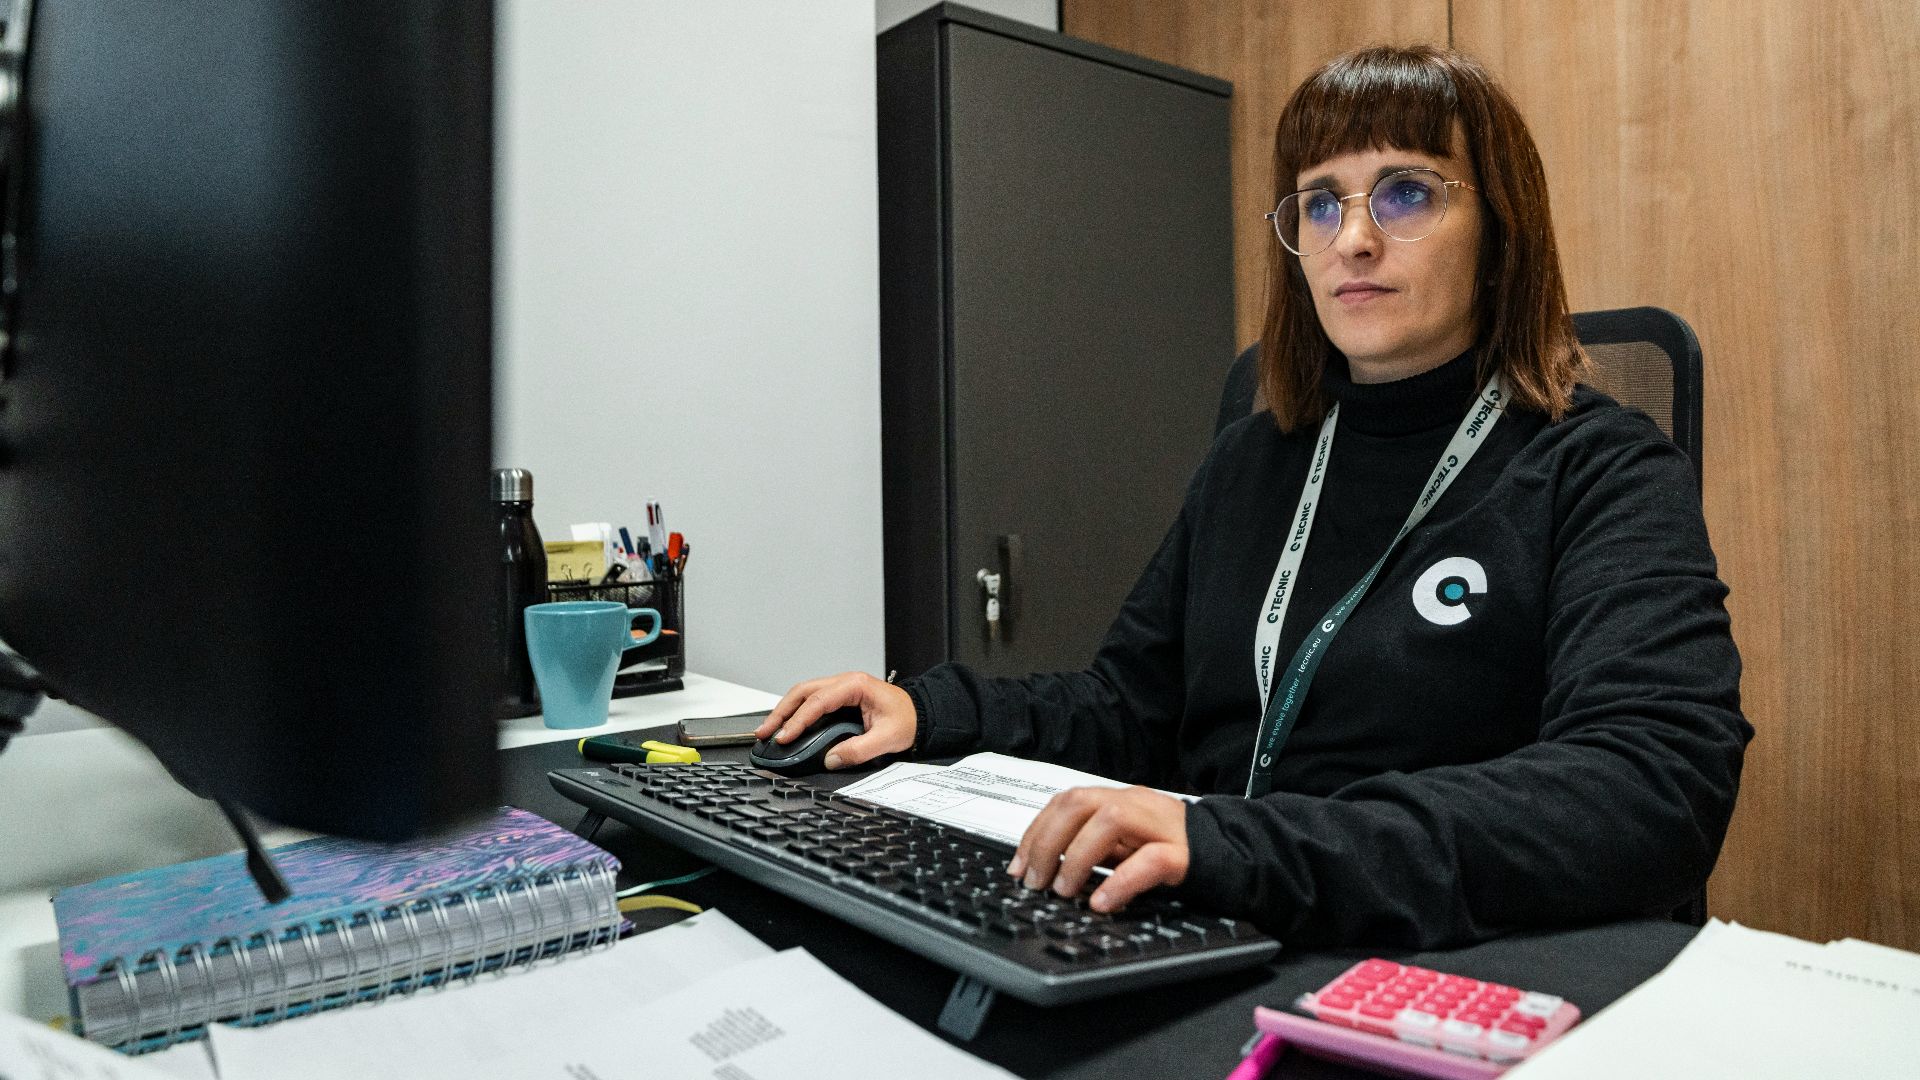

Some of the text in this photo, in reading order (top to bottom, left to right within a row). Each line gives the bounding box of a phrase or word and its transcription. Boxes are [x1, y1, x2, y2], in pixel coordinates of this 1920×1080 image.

[1466, 400, 1497, 438] TECNIC
[1315, 435, 1329, 475] TECNIC
[1421, 466, 1451, 508] TECNIC
[1294, 502, 1312, 542] TECNIC
[1270, 569, 1291, 611] TECNIC
[1260, 645, 1272, 694] TECNIC
[1266, 737, 1276, 749] we
[1272, 712, 1286, 736] evolve
[1281, 677, 1300, 711] together
[1298, 637, 1321, 673] tecnic.eu
